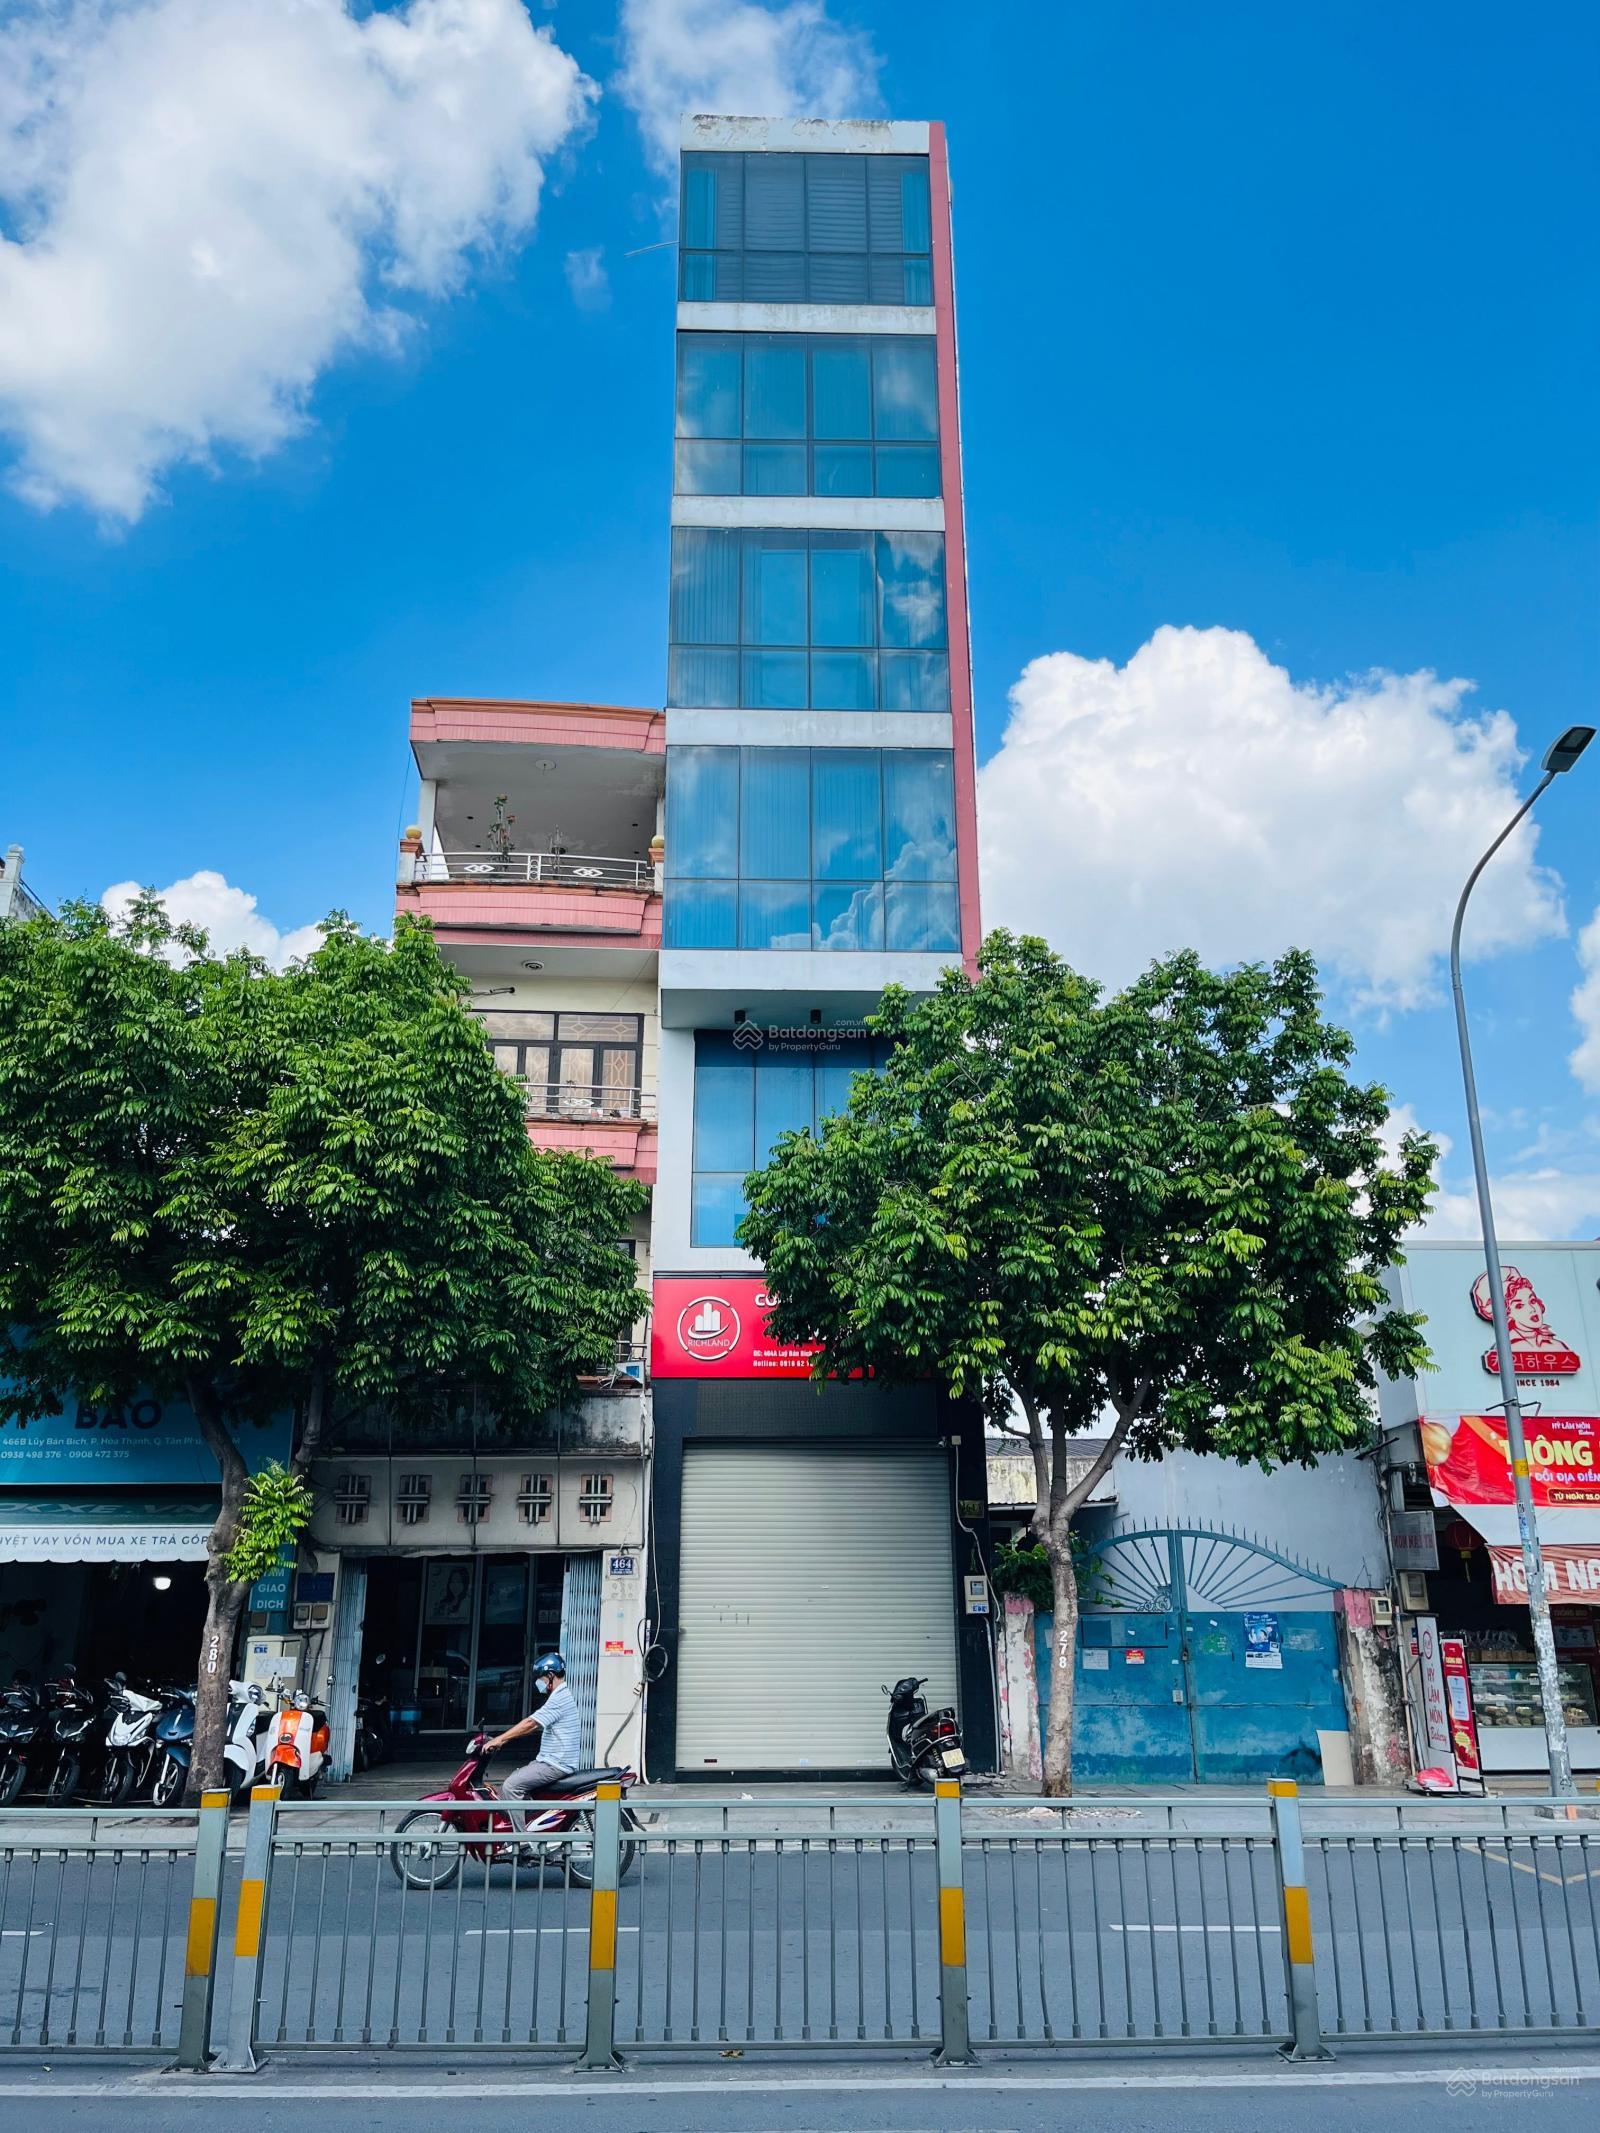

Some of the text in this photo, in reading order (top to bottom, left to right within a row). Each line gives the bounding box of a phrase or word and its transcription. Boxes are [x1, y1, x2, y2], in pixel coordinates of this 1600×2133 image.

[687, 1339, 731, 1347] RICHLAND
[33, 1536, 60, 1545] VAY
[96, 1536, 125, 1545] MUA
[130, 1536, 146, 1545] XE
[612, 1559, 631, 1568] 464
[258, 1584, 286, 1592] GIAO
[1059, 1630, 1068, 1668] 278
[207, 1635, 219, 1673] 280
